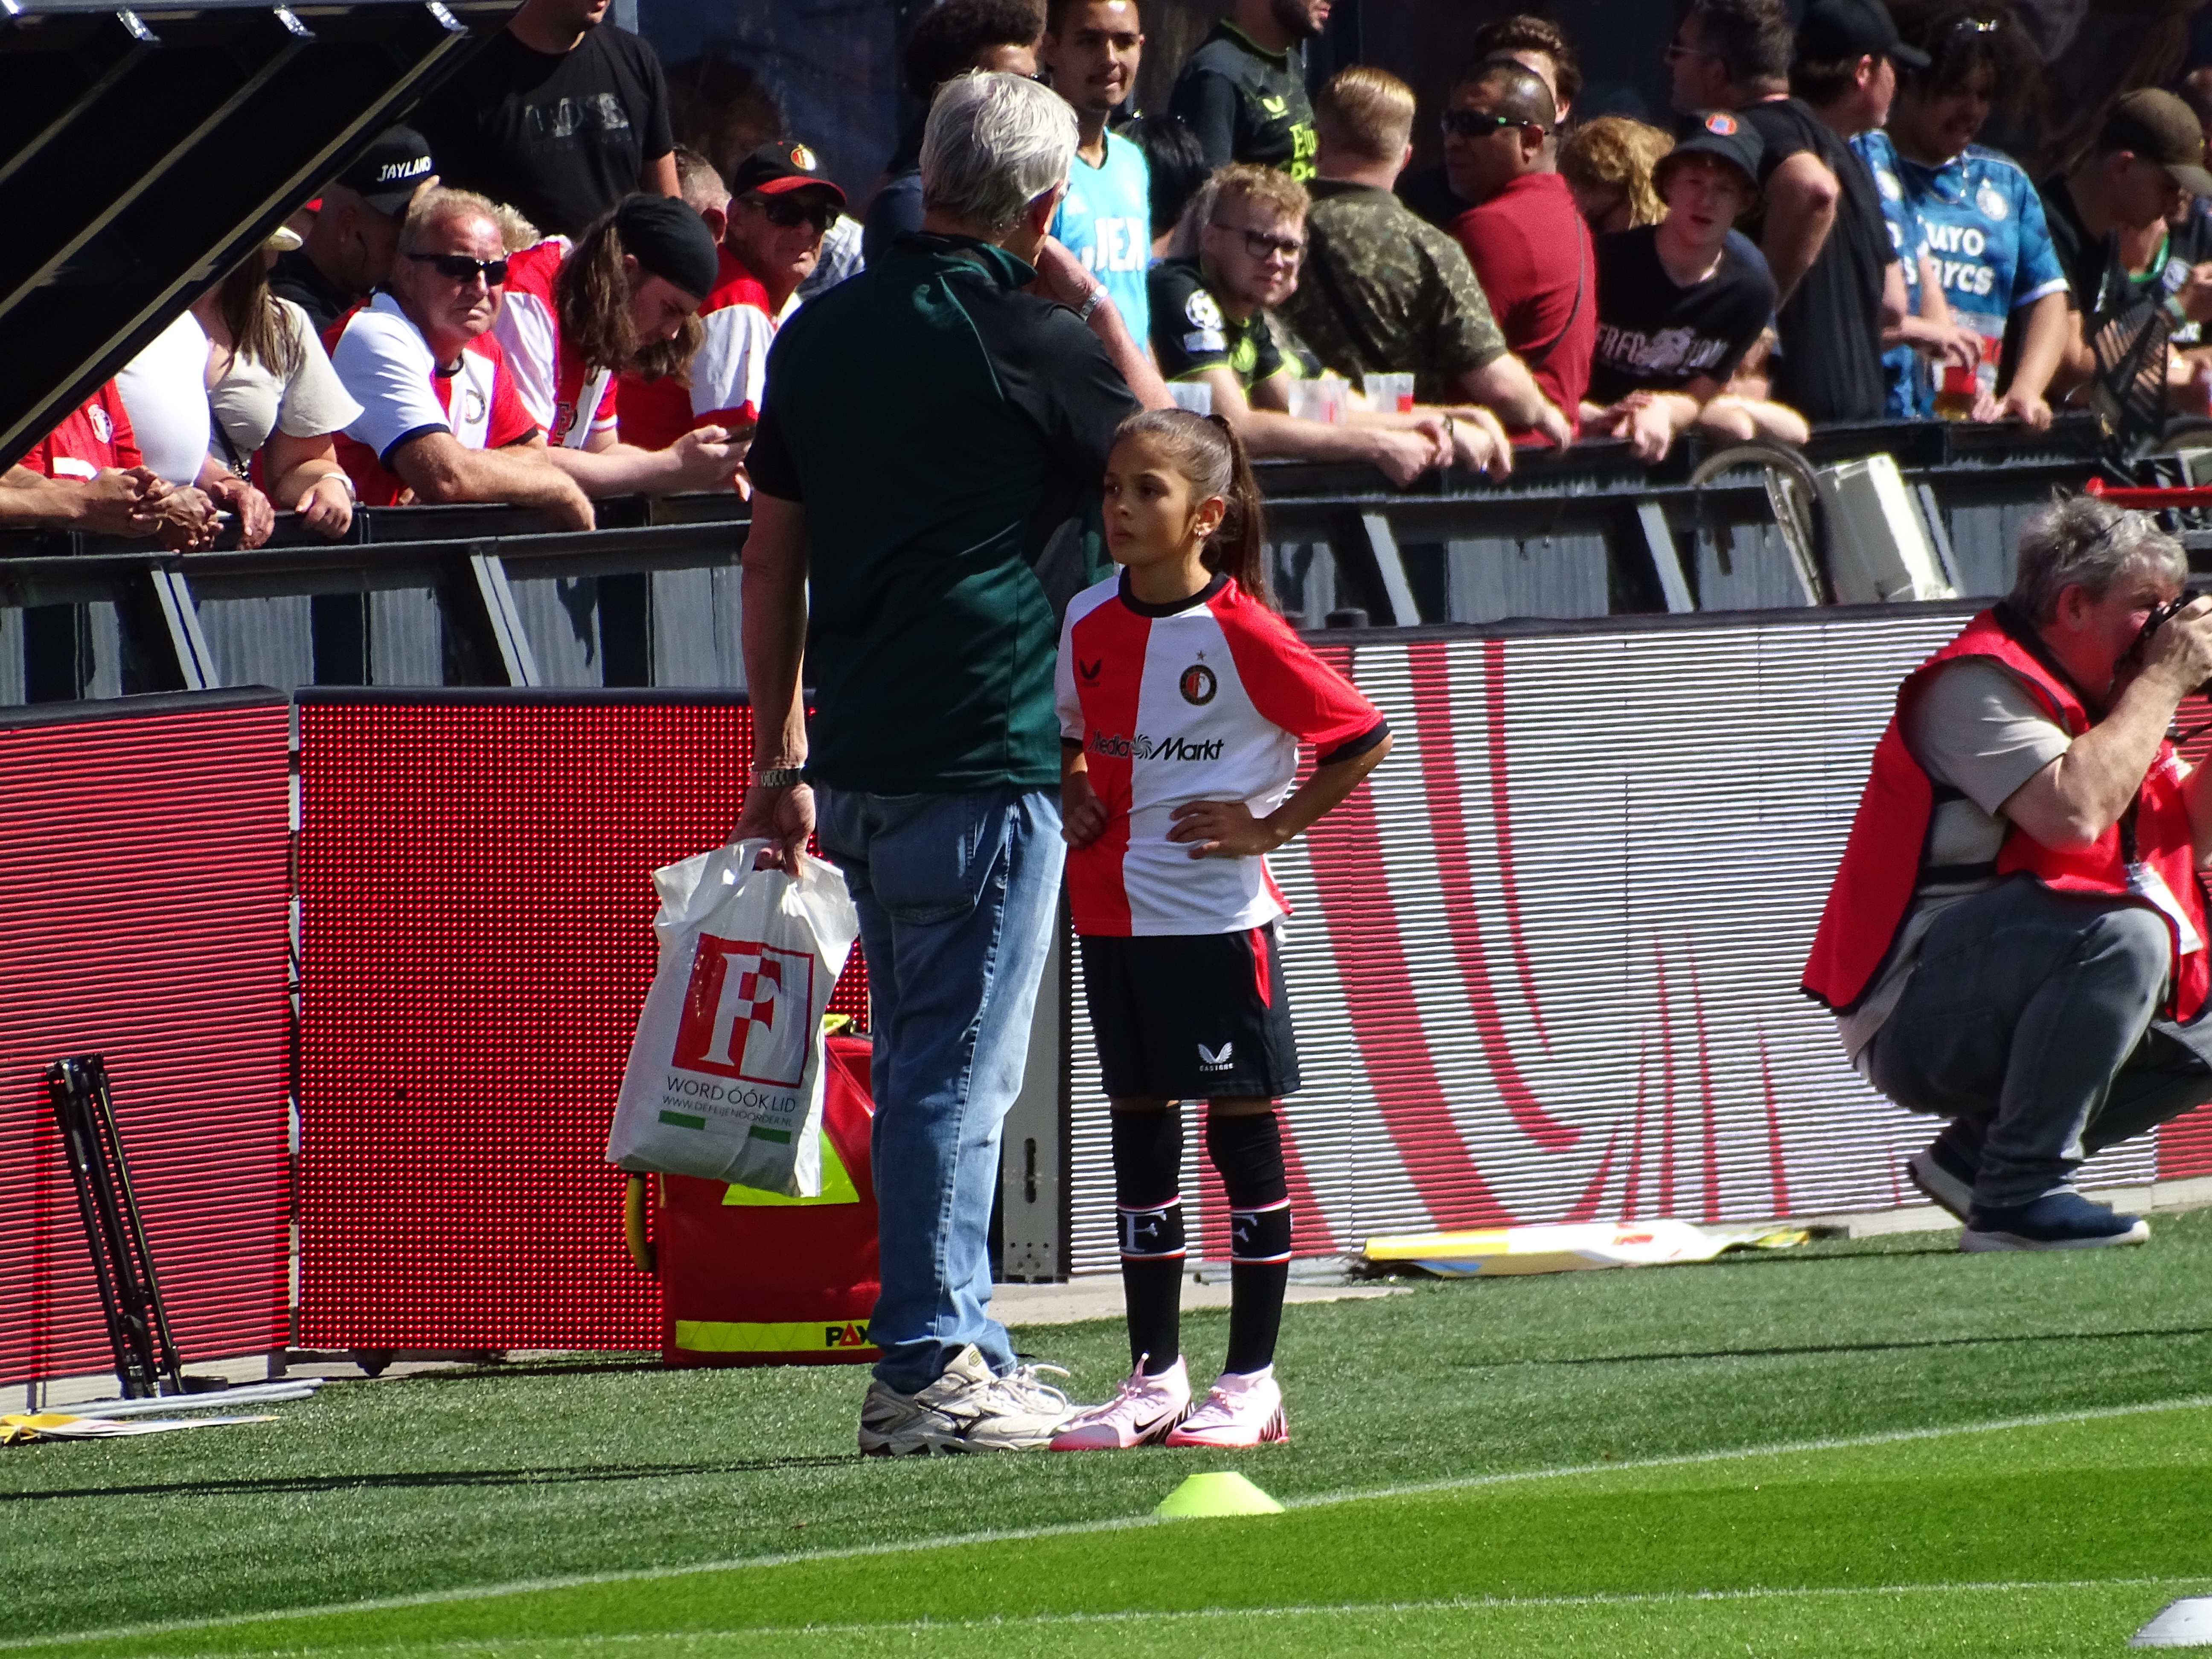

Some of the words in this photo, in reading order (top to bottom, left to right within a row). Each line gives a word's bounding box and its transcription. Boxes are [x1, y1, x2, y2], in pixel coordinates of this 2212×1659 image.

[1917, 215, 1985, 256] uro
[1148, 737, 1224, 761] Markt
[668, 1075, 724, 1100] WORD
[772, 1095, 796, 1113] LID
